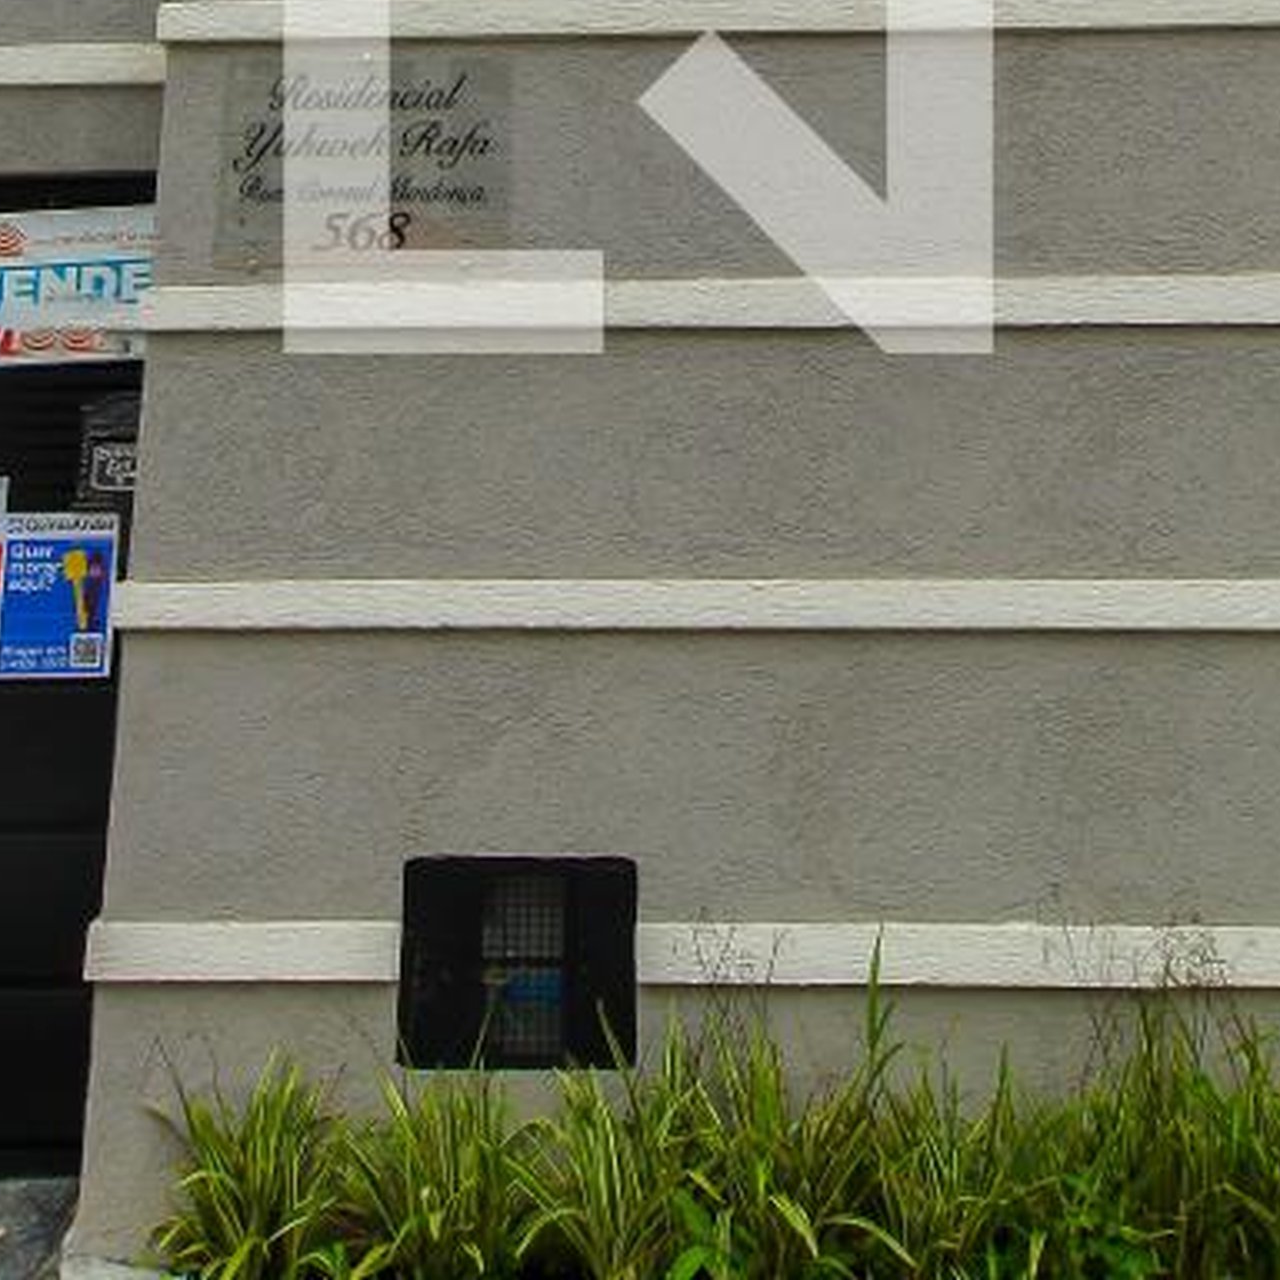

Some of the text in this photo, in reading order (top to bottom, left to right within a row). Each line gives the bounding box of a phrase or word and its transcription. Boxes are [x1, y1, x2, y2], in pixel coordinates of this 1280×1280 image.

[268, 73, 467, 112] Residencial
[400, 120, 493, 169] Rafa
[312, 212, 412, 251] 568
